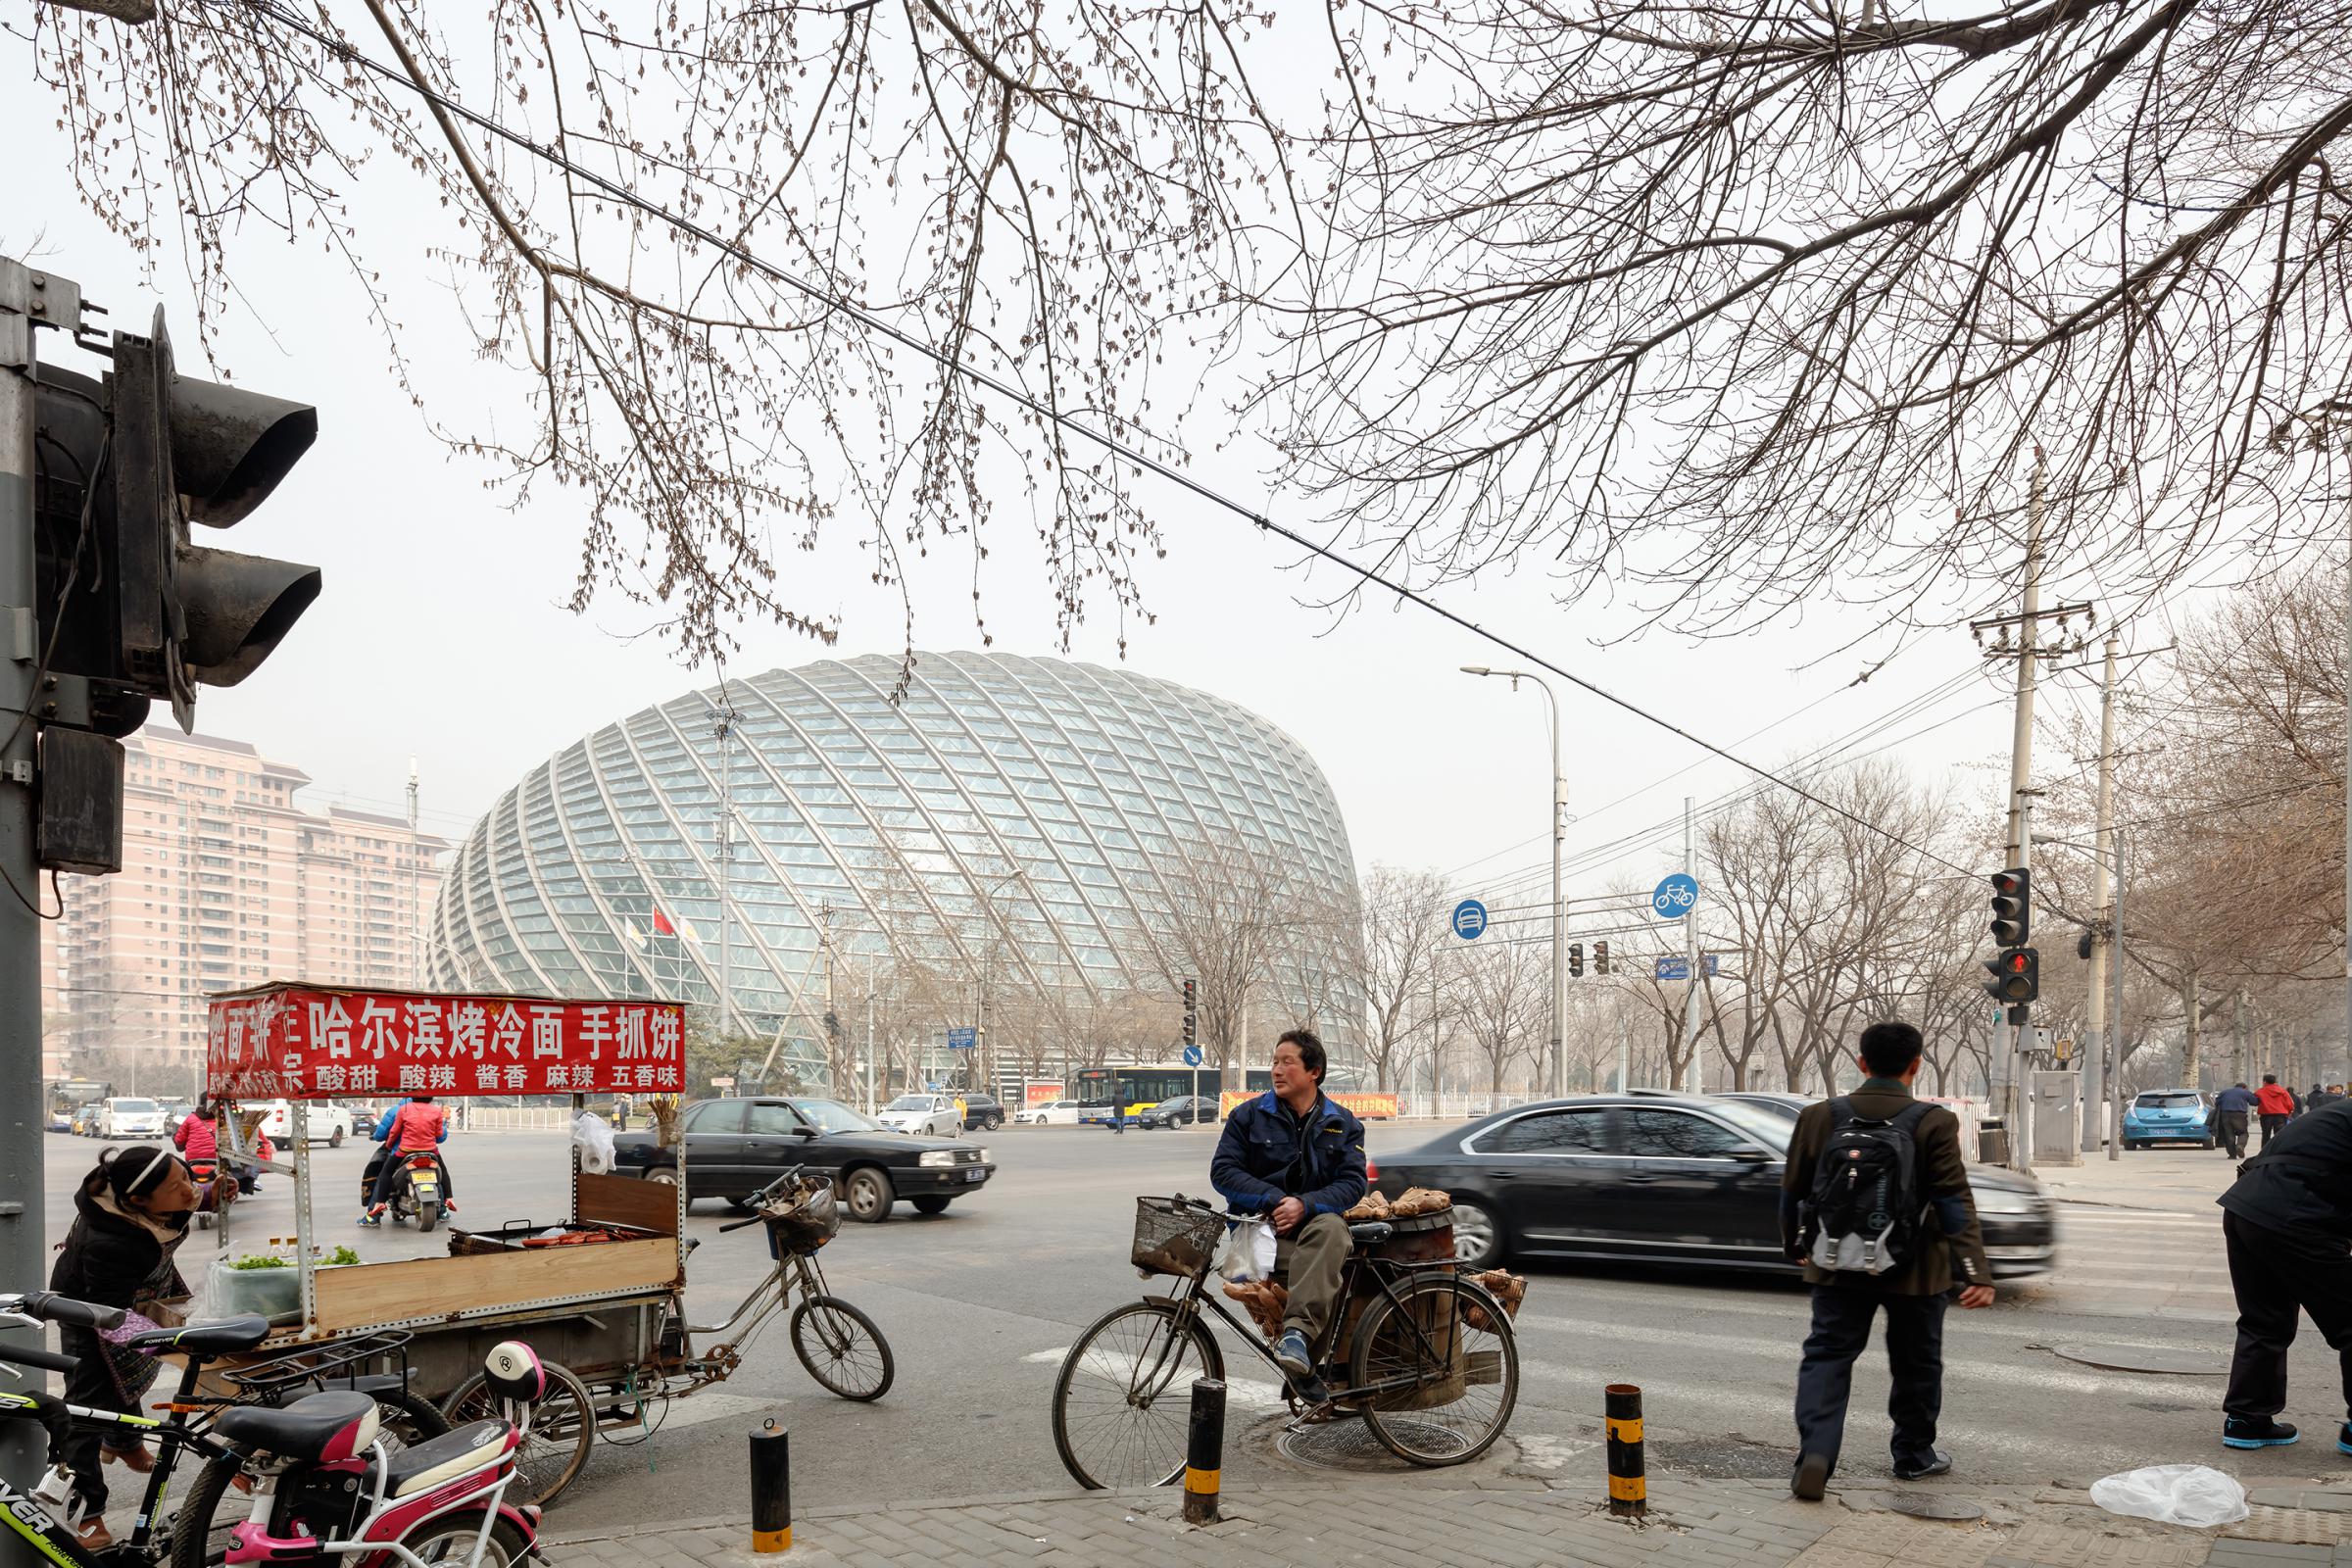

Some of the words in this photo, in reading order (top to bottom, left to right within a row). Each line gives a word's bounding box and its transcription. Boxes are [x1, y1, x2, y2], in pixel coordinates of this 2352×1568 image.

[309, 996, 564, 1060] 哈尔滨烤冷面
[579, 1004, 680, 1061] 手抓饼
[316, 1063, 379, 1091] 酸甜
[399, 1063, 457, 1090] 酸辣
[475, 1063, 528, 1090] 酱香
[545, 1063, 595, 1088] 麻辣
[611, 1064, 679, 1088] 五香味
[143, 1336, 175, 1345] FOREVER
[0, 1477, 55, 1535] VER
